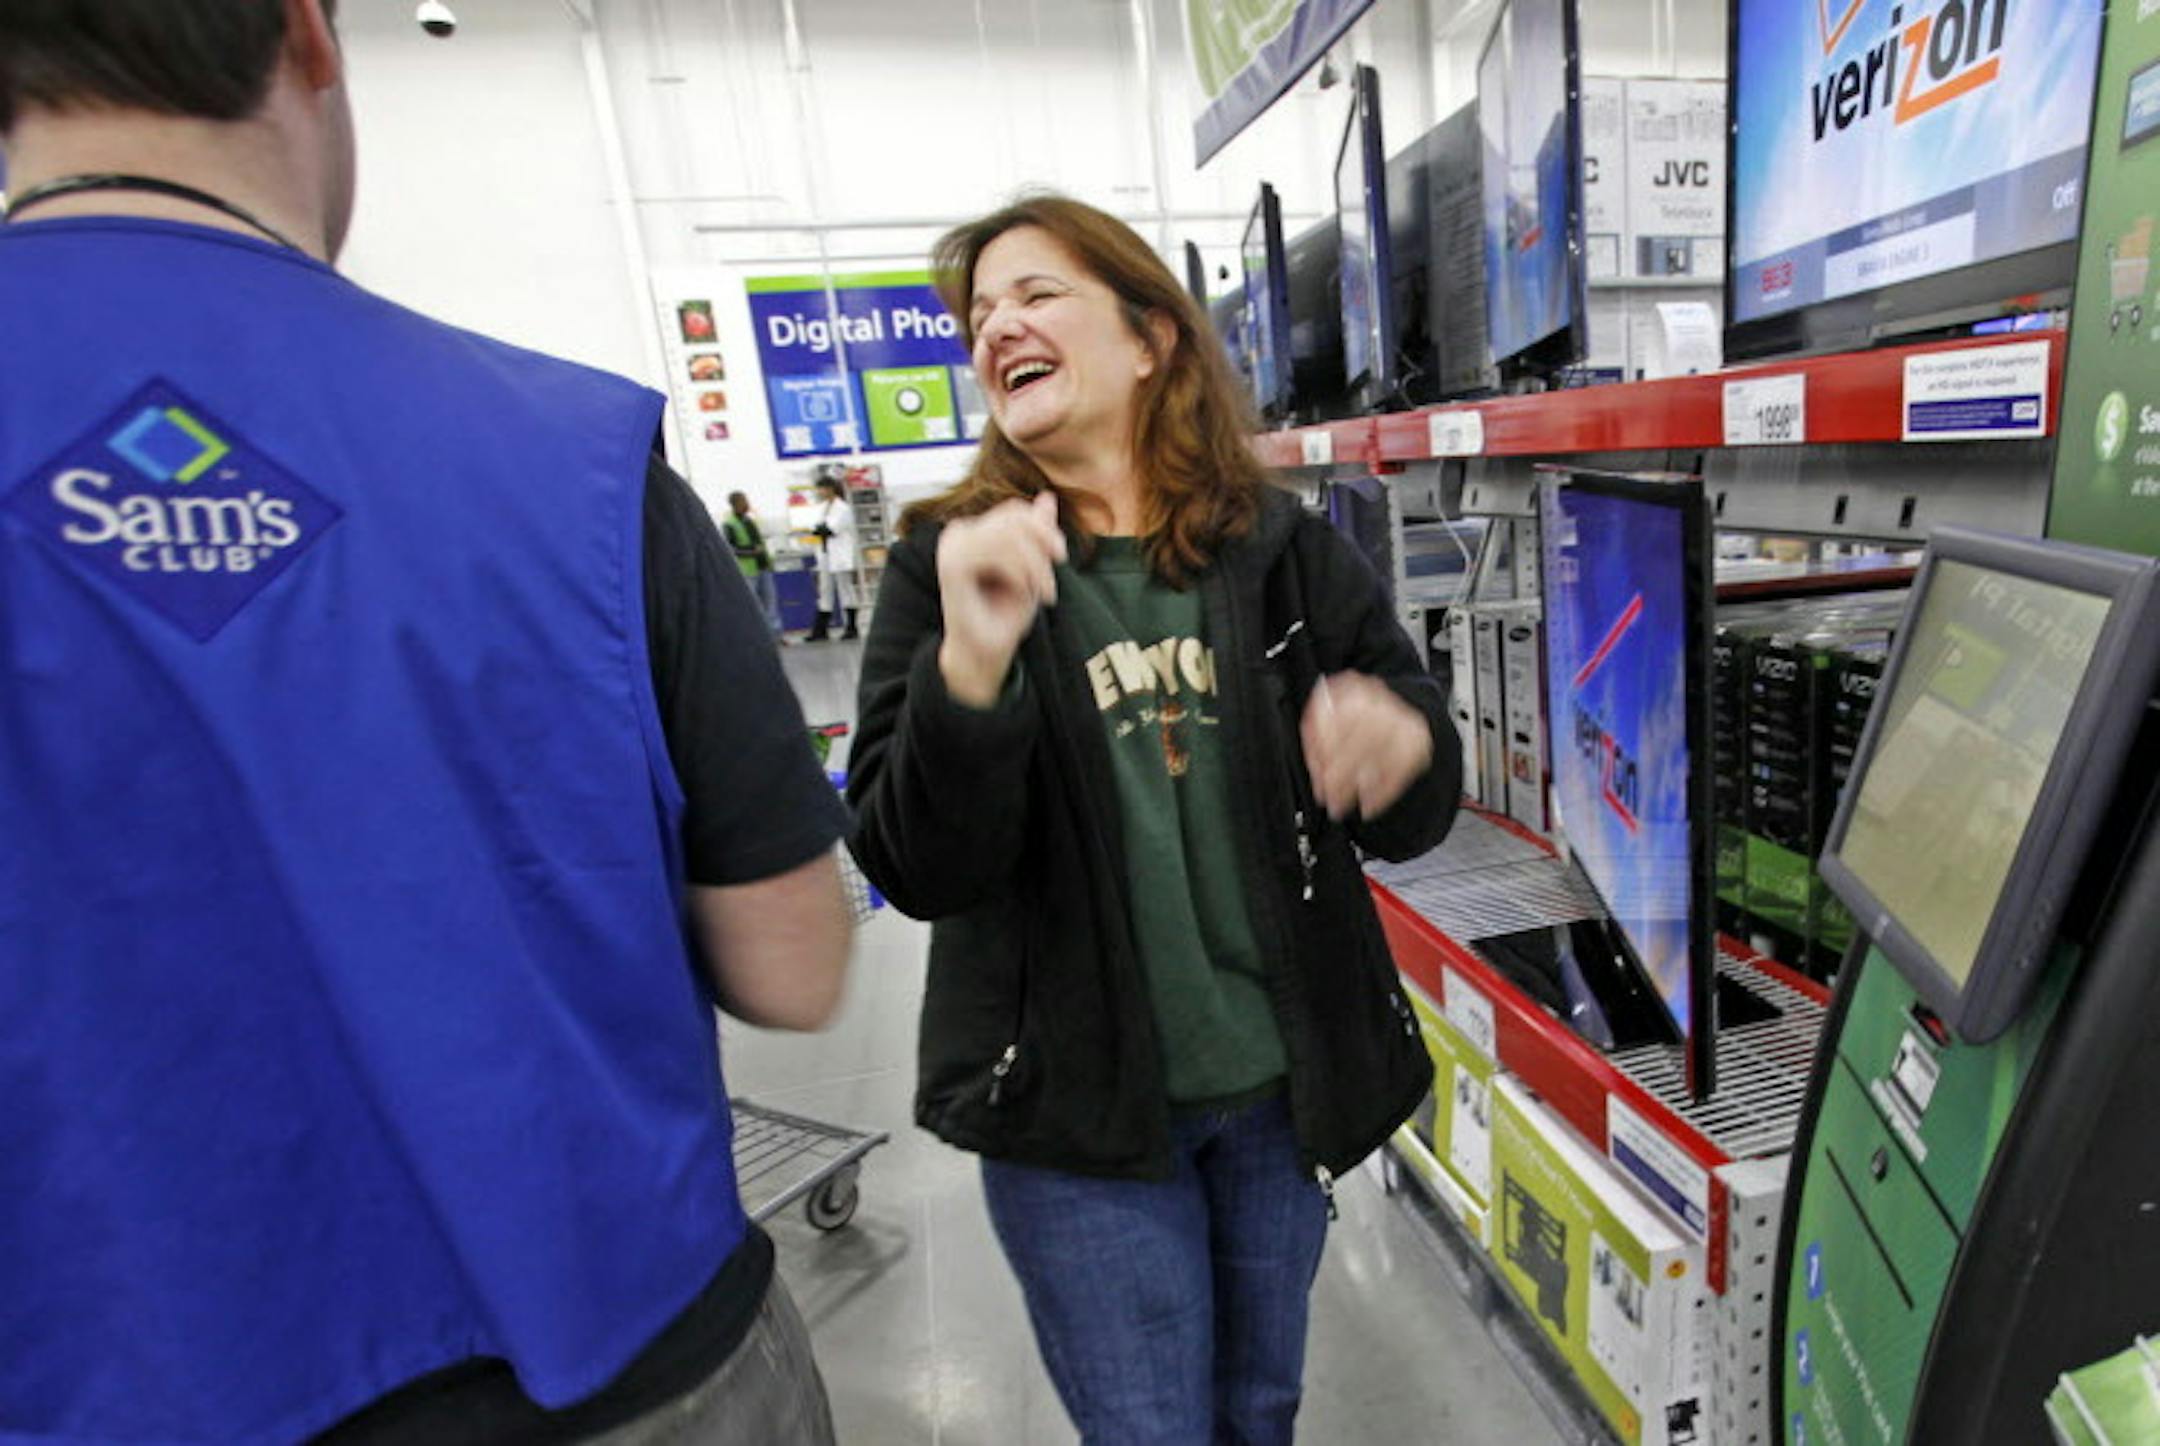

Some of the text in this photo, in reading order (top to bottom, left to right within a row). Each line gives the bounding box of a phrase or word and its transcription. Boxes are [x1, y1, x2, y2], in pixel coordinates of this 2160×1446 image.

[1811, 0, 2007, 142] verizon
[1653, 160, 1709, 187] JVC
[768, 305, 956, 353] Digtal Pho
[51, 468, 301, 548] Sam's
[121, 545, 257, 573] CLUB
